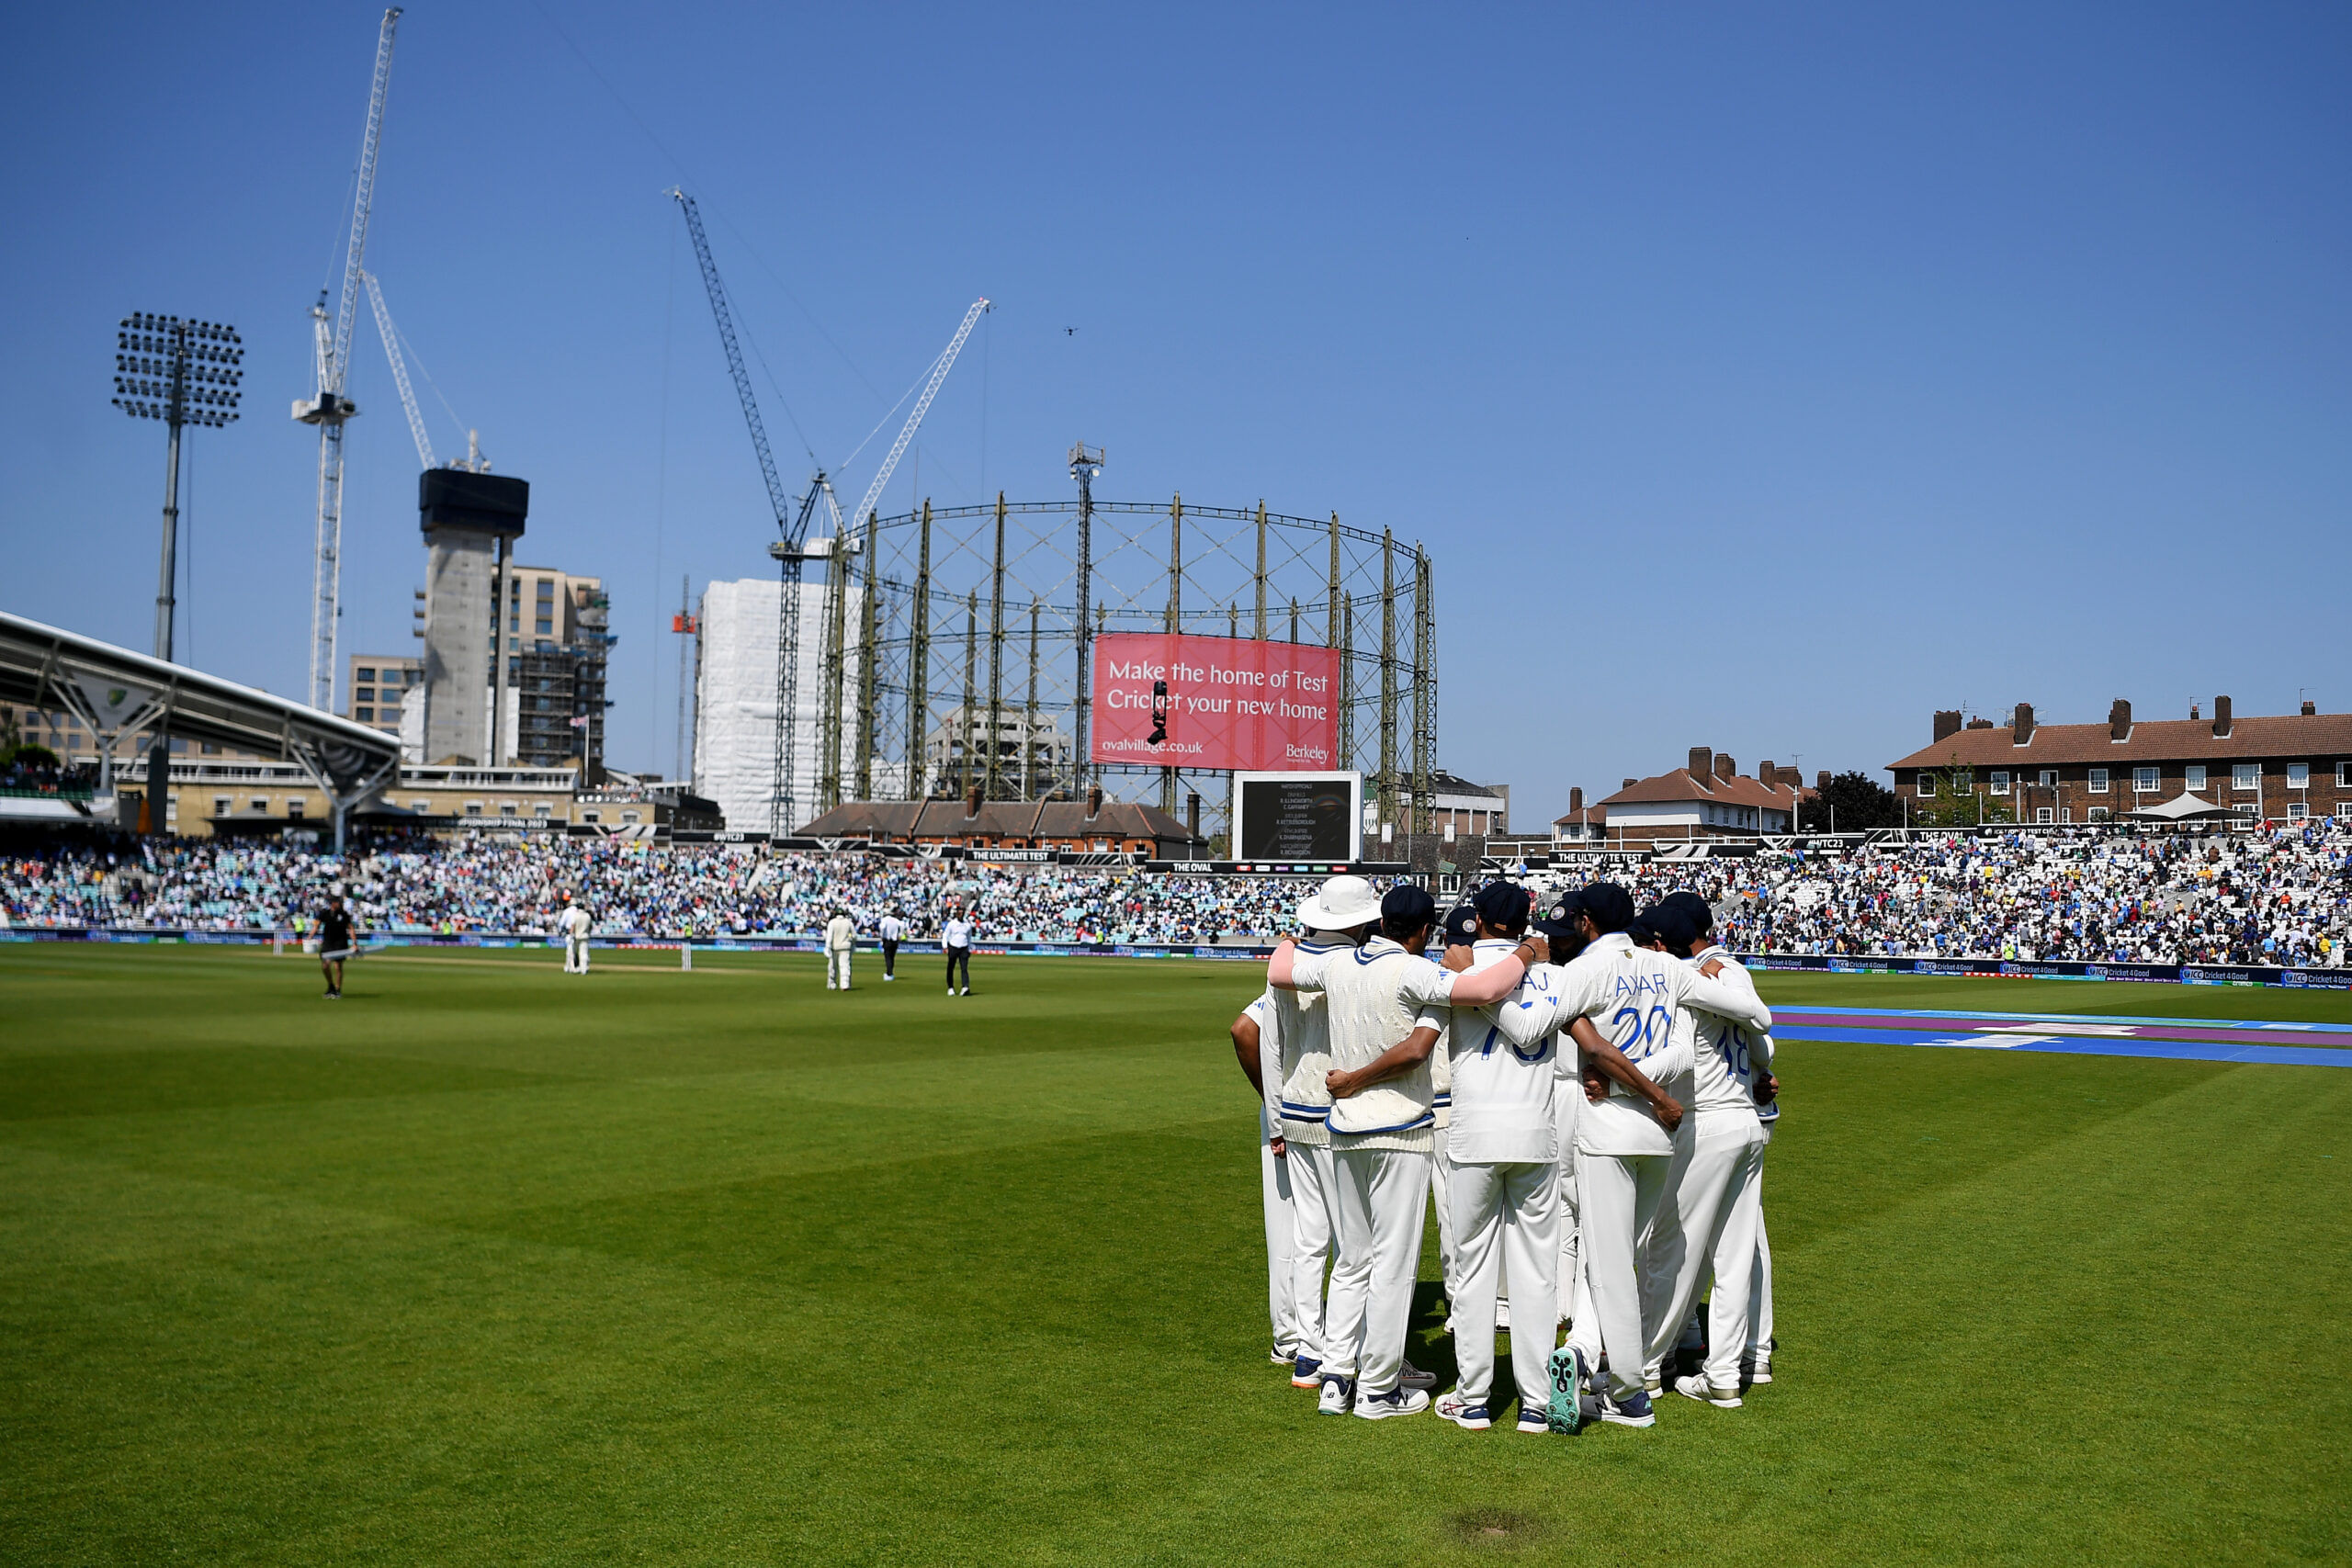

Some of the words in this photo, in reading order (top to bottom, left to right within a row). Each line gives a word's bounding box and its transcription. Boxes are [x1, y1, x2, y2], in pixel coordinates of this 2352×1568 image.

[1109, 660, 1166, 680] Make
[1171, 662, 1204, 682] the
[1210, 664, 1265, 686] home
[1270, 670, 1289, 688] of
[1293, 671, 1328, 693] Test
[1107, 689, 1182, 710] Cricket
[1187, 696, 1231, 716] your
[1237, 700, 1275, 716] new
[1280, 698, 1328, 720] home
[1102, 739, 1203, 754] ovalvillage.co.uk
[1286, 743, 1329, 764] Berkeley
[503, 818, 526, 827] FINAL
[526, 818, 548, 828] 2023
[1919, 831, 1939, 841] THE
[973, 851, 989, 861] THE
[989, 851, 1028, 862] ULTIMATE
[1029, 852, 1049, 862] TEST
[1558, 852, 1576, 863] THE
[1621, 853, 1643, 863] TEST
[1173, 863, 1191, 872] THE
[1190, 863, 1213, 872] OVAL
[1766, 958, 1784, 966] Cricket
[2021, 965, 2041, 974] Cricket
[2109, 968, 2130, 976] Cricket
[2134, 969, 2150, 977] Good
[2204, 971, 2227, 979] Cricket
[2232, 972, 2248, 980] Good
[2308, 974, 2333, 983] Cricket
[2338, 976, 2352, 984] Goo
[1615, 974, 1668, 997] AXAR
[1612, 1006, 1671, 1064] 20
[1716, 1023, 1750, 1080] 18
